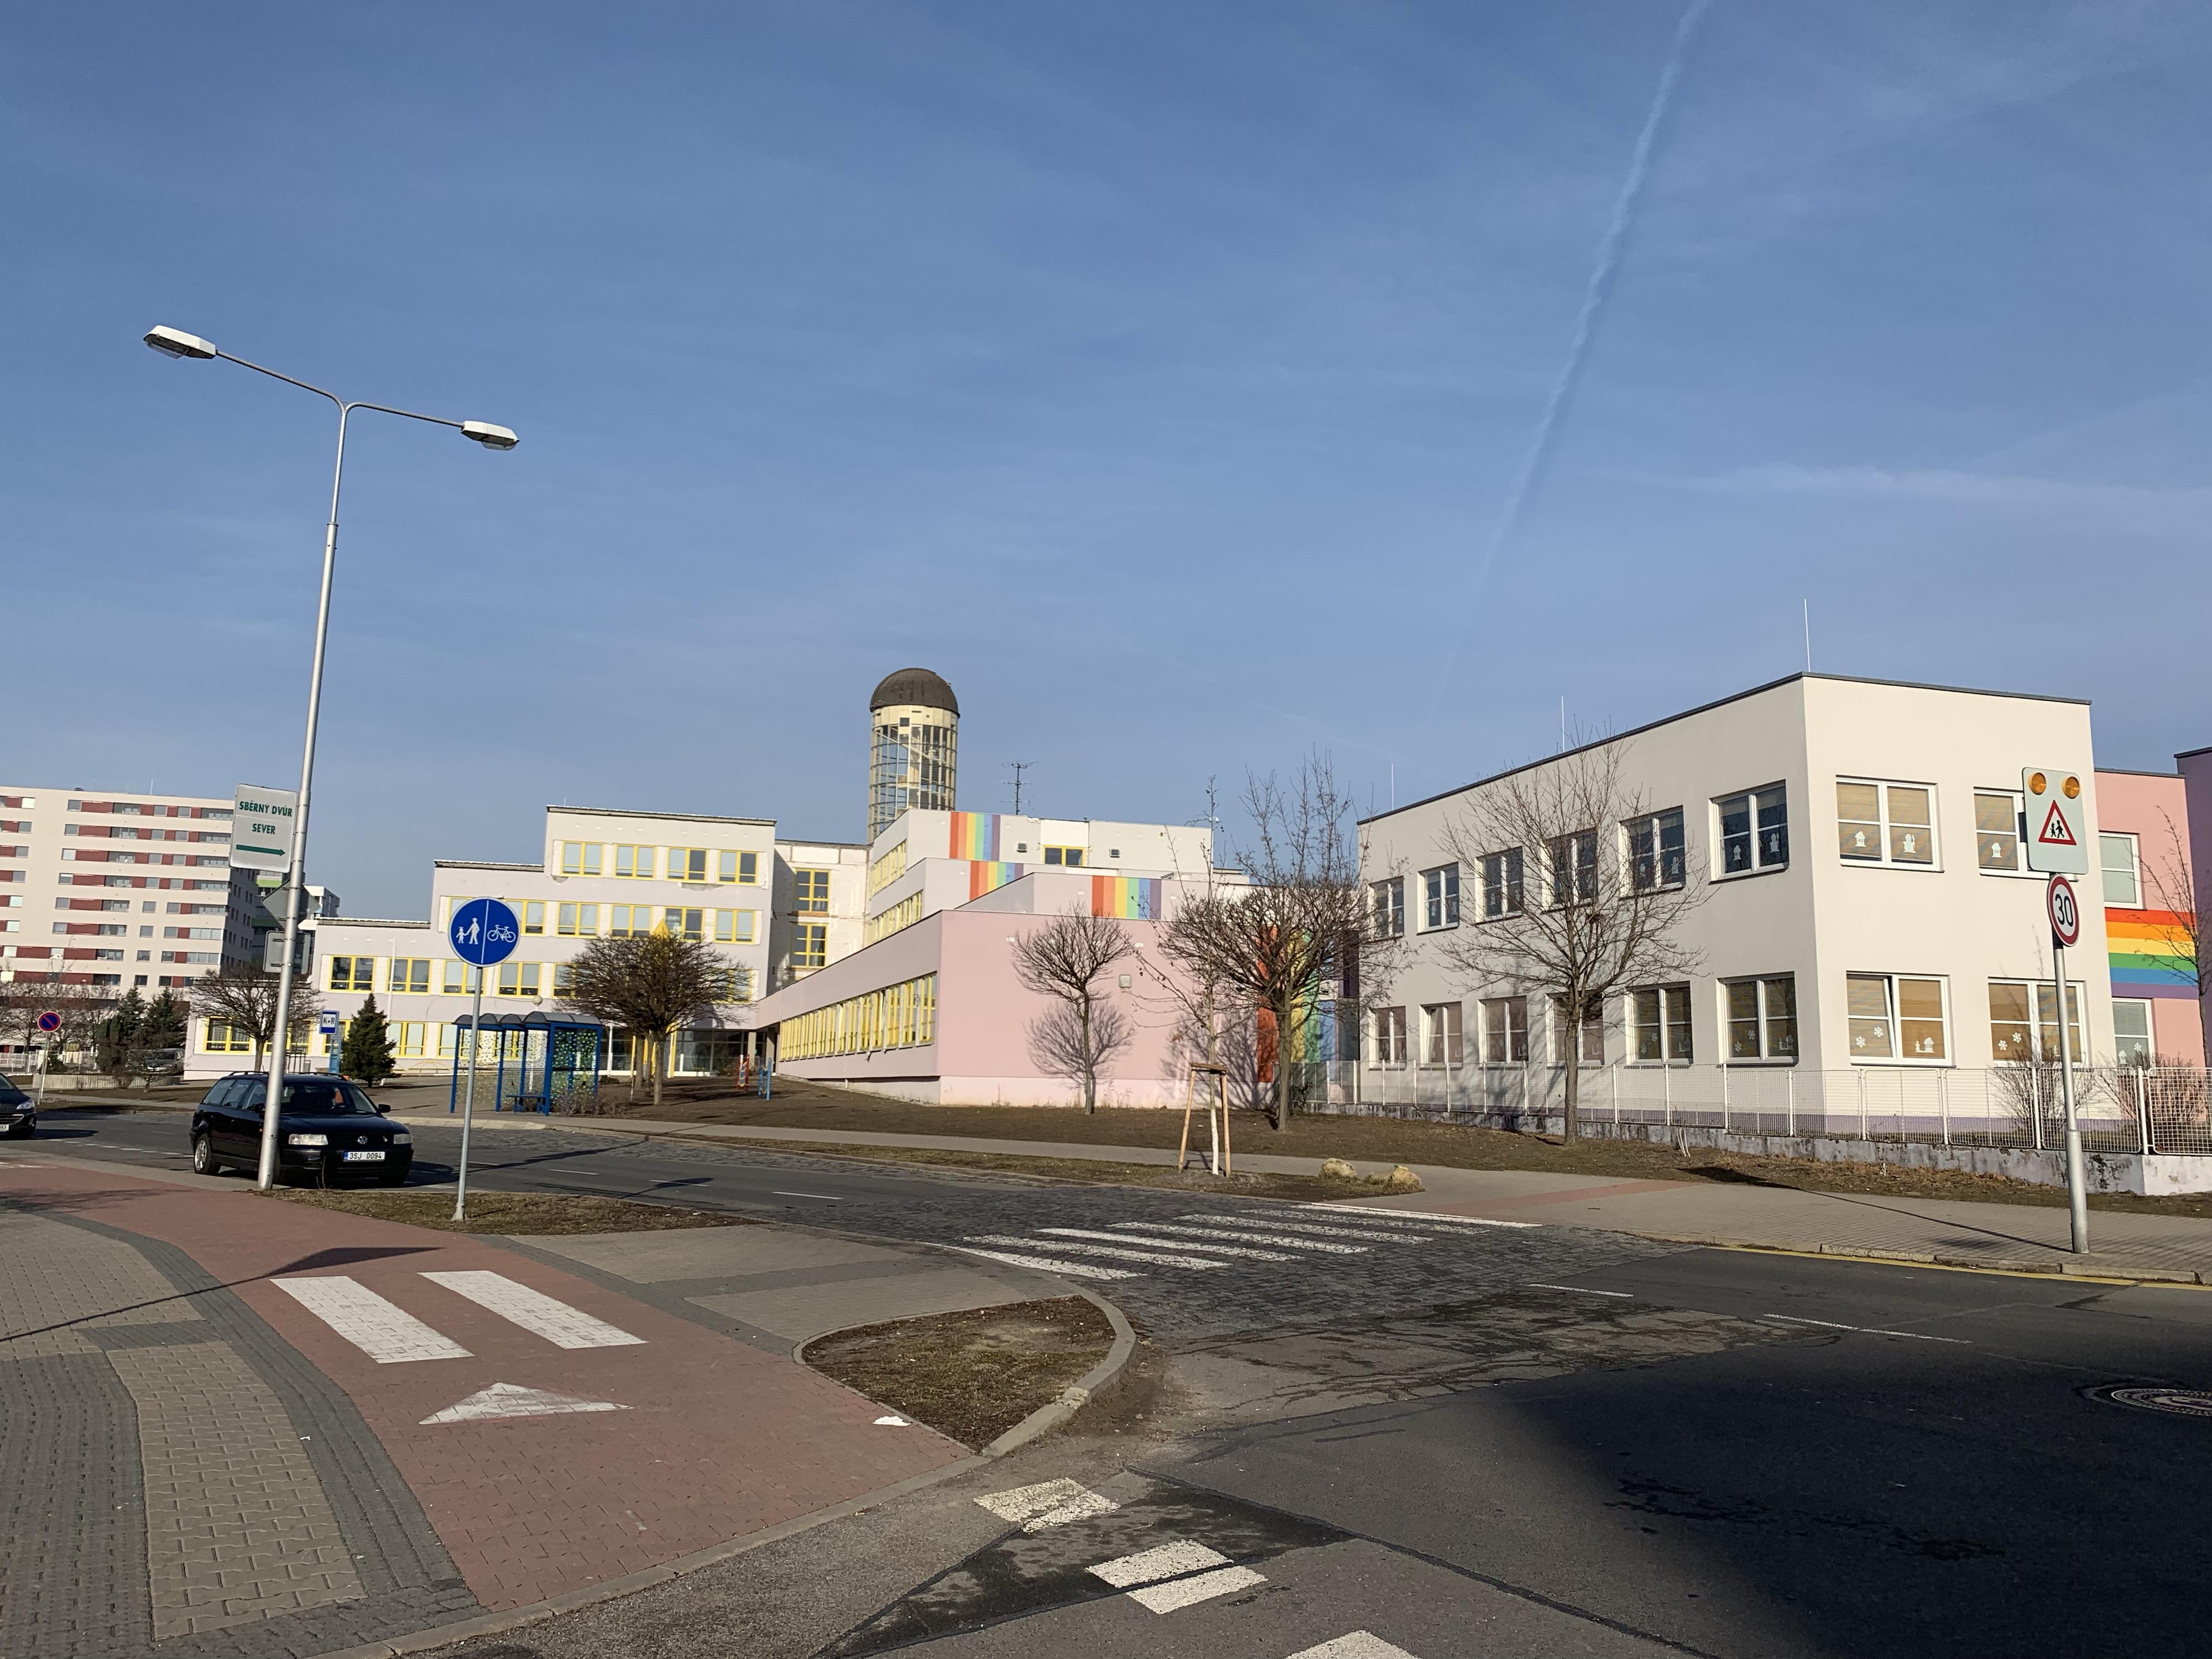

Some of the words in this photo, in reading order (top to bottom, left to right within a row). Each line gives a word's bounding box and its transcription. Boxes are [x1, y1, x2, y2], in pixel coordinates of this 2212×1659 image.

[239, 800, 270, 813] SBĚRNÝ
[272, 805, 293, 817] DVŮR
[252, 823, 275, 834] SEVER
[2055, 894, 2073, 927] 30
